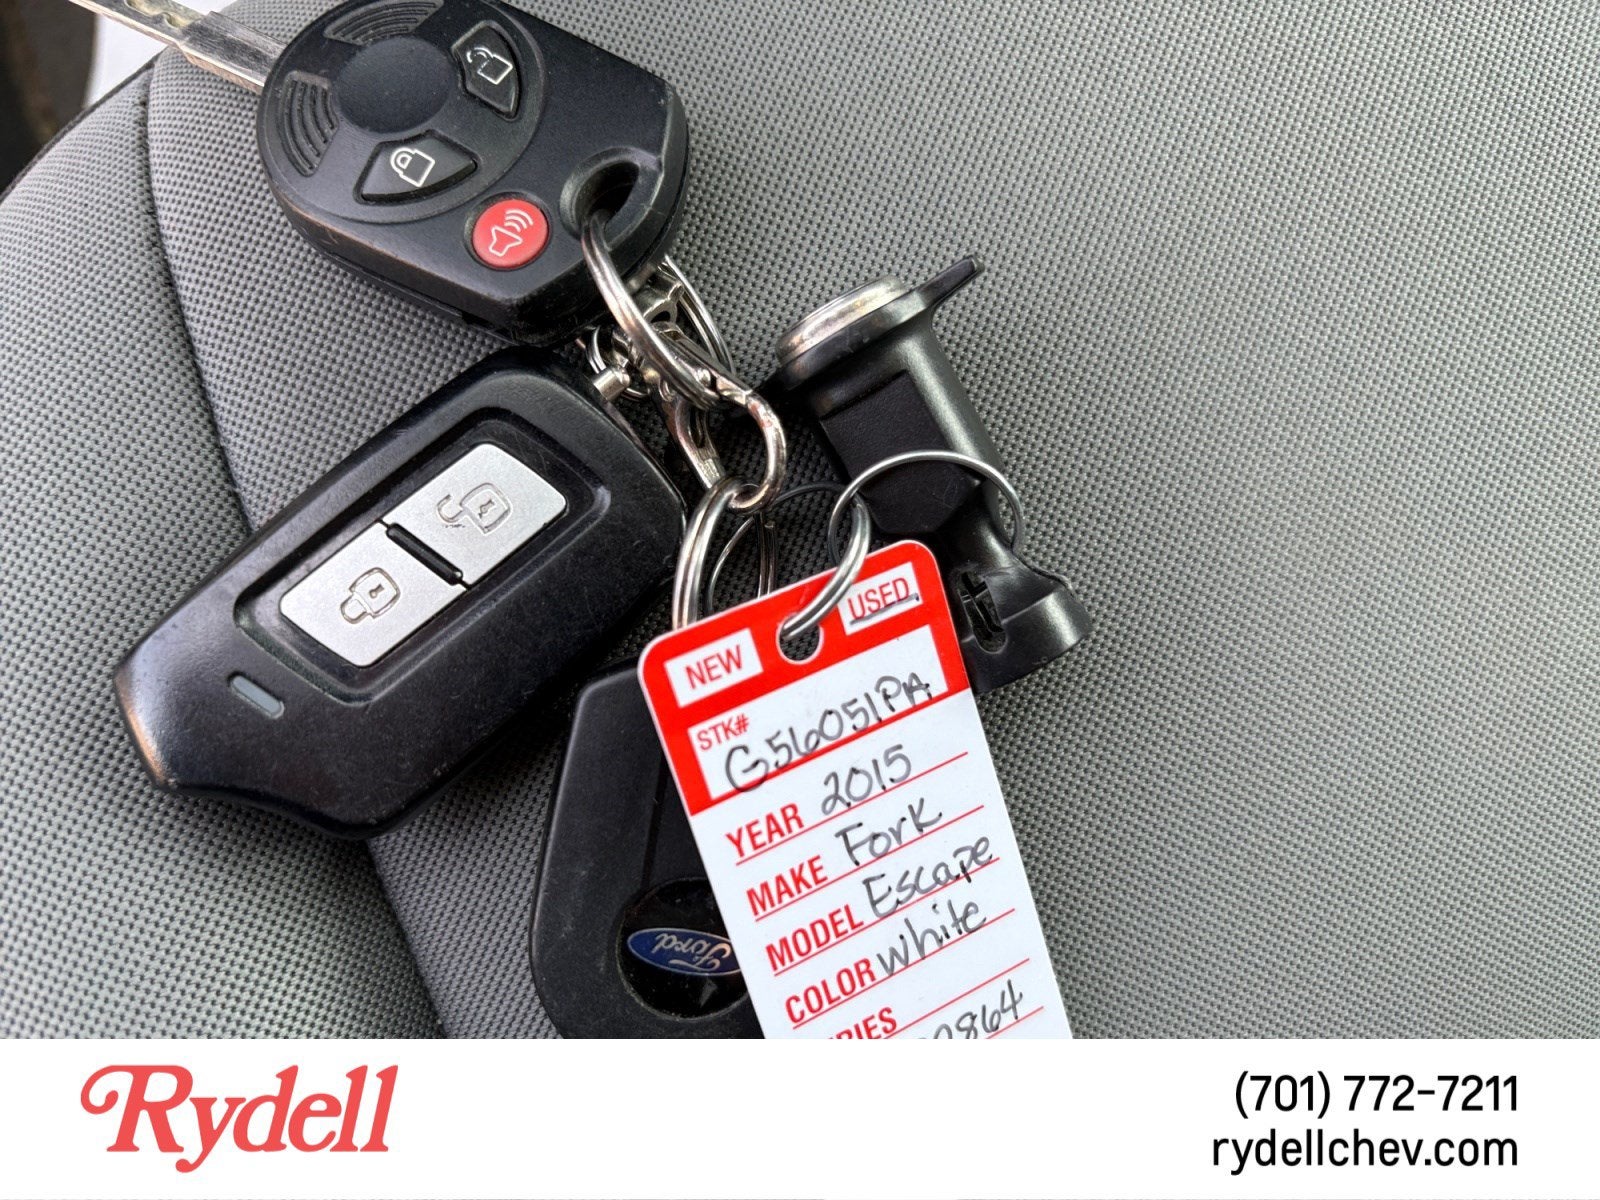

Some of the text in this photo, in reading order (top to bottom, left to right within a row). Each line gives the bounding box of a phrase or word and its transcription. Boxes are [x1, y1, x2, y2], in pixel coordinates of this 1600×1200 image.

[848, 577, 911, 620] USED
[685, 644, 744, 690] NEW
[696, 713, 749, 752] STK#
[724, 671, 933, 793] G56051PA
[820, 743, 912, 816] 2015
[725, 803, 805, 857] YEAR
[746, 855, 828, 917] MAKE
[861, 835, 994, 919] Escape
[651, 932, 731, 972] Ford
[765, 904, 865, 971] MODEL
[785, 958, 877, 1024] COLOR
[828, 1006, 898, 1039] RIES
